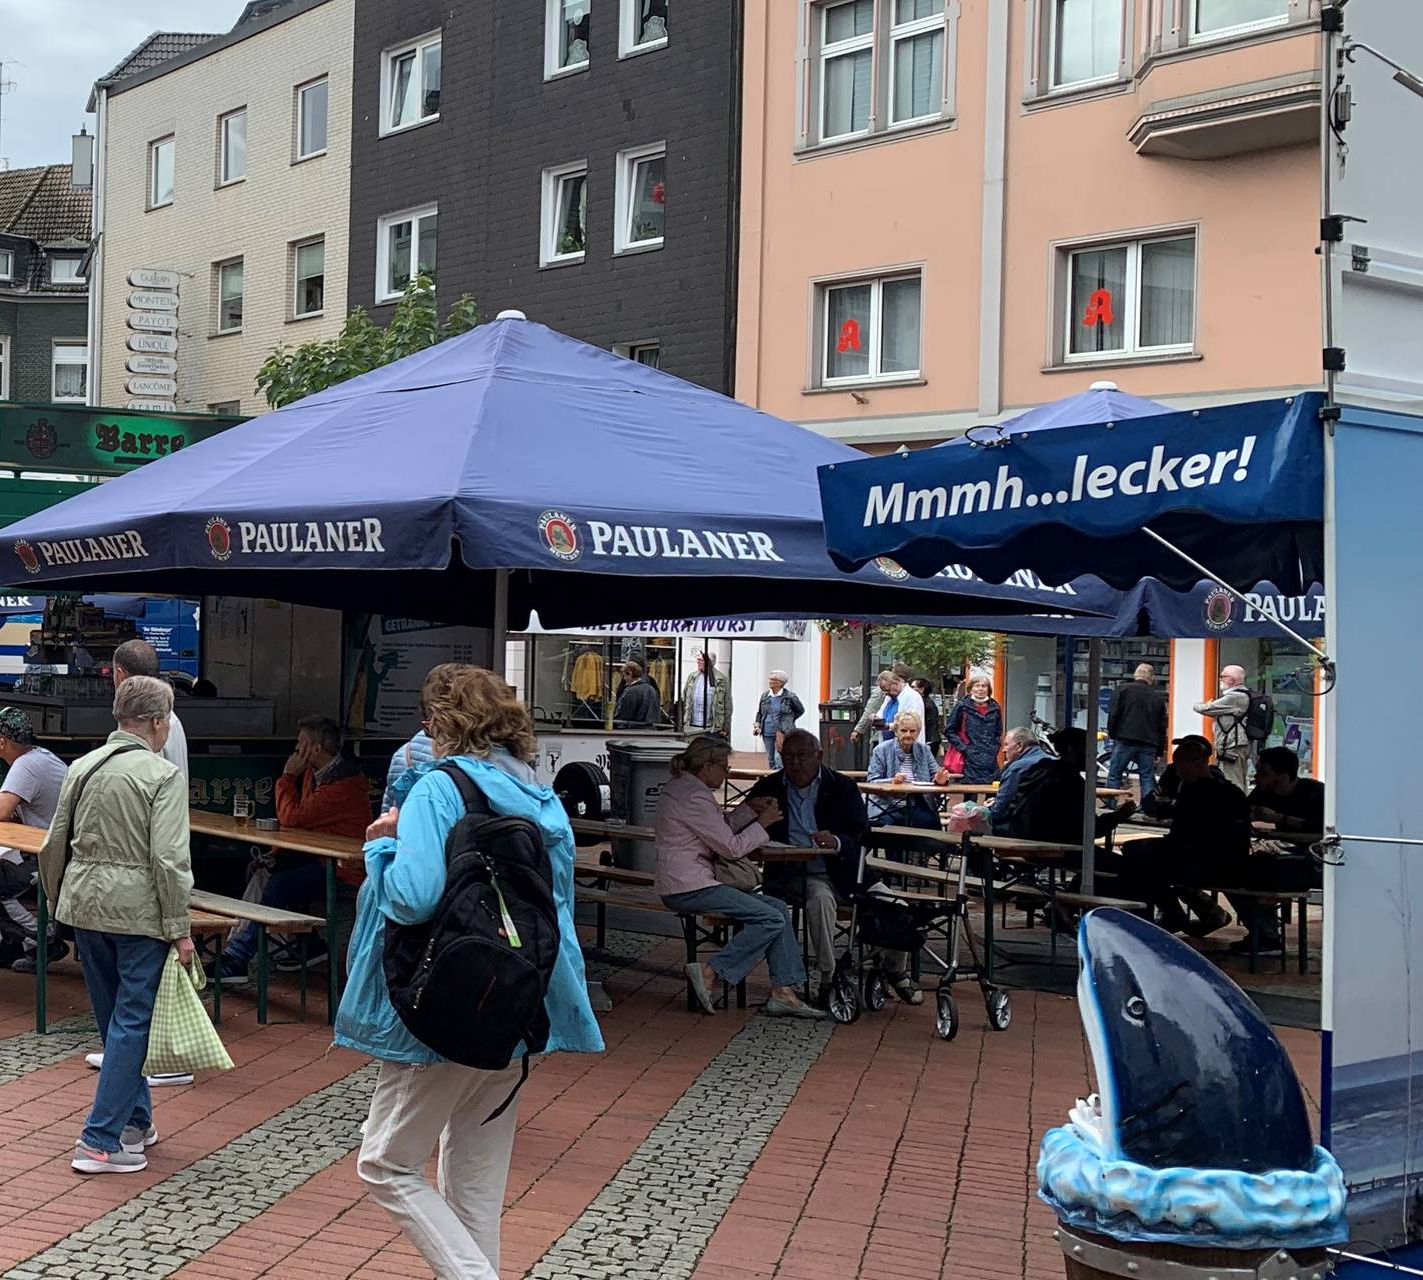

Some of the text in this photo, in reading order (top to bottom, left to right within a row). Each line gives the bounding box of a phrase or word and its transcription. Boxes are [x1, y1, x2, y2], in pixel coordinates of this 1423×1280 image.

[138, 316, 171, 326] PAYOT
[133, 383, 173, 392] LANCÔME
[95, 423, 186, 458] Barre
[863, 435, 1257, 527] Mmmh...lecker!
[37, 530, 150, 567] PAULANER
[238, 517, 386, 554] PAULANER
[586, 520, 785, 563] PAULANER
